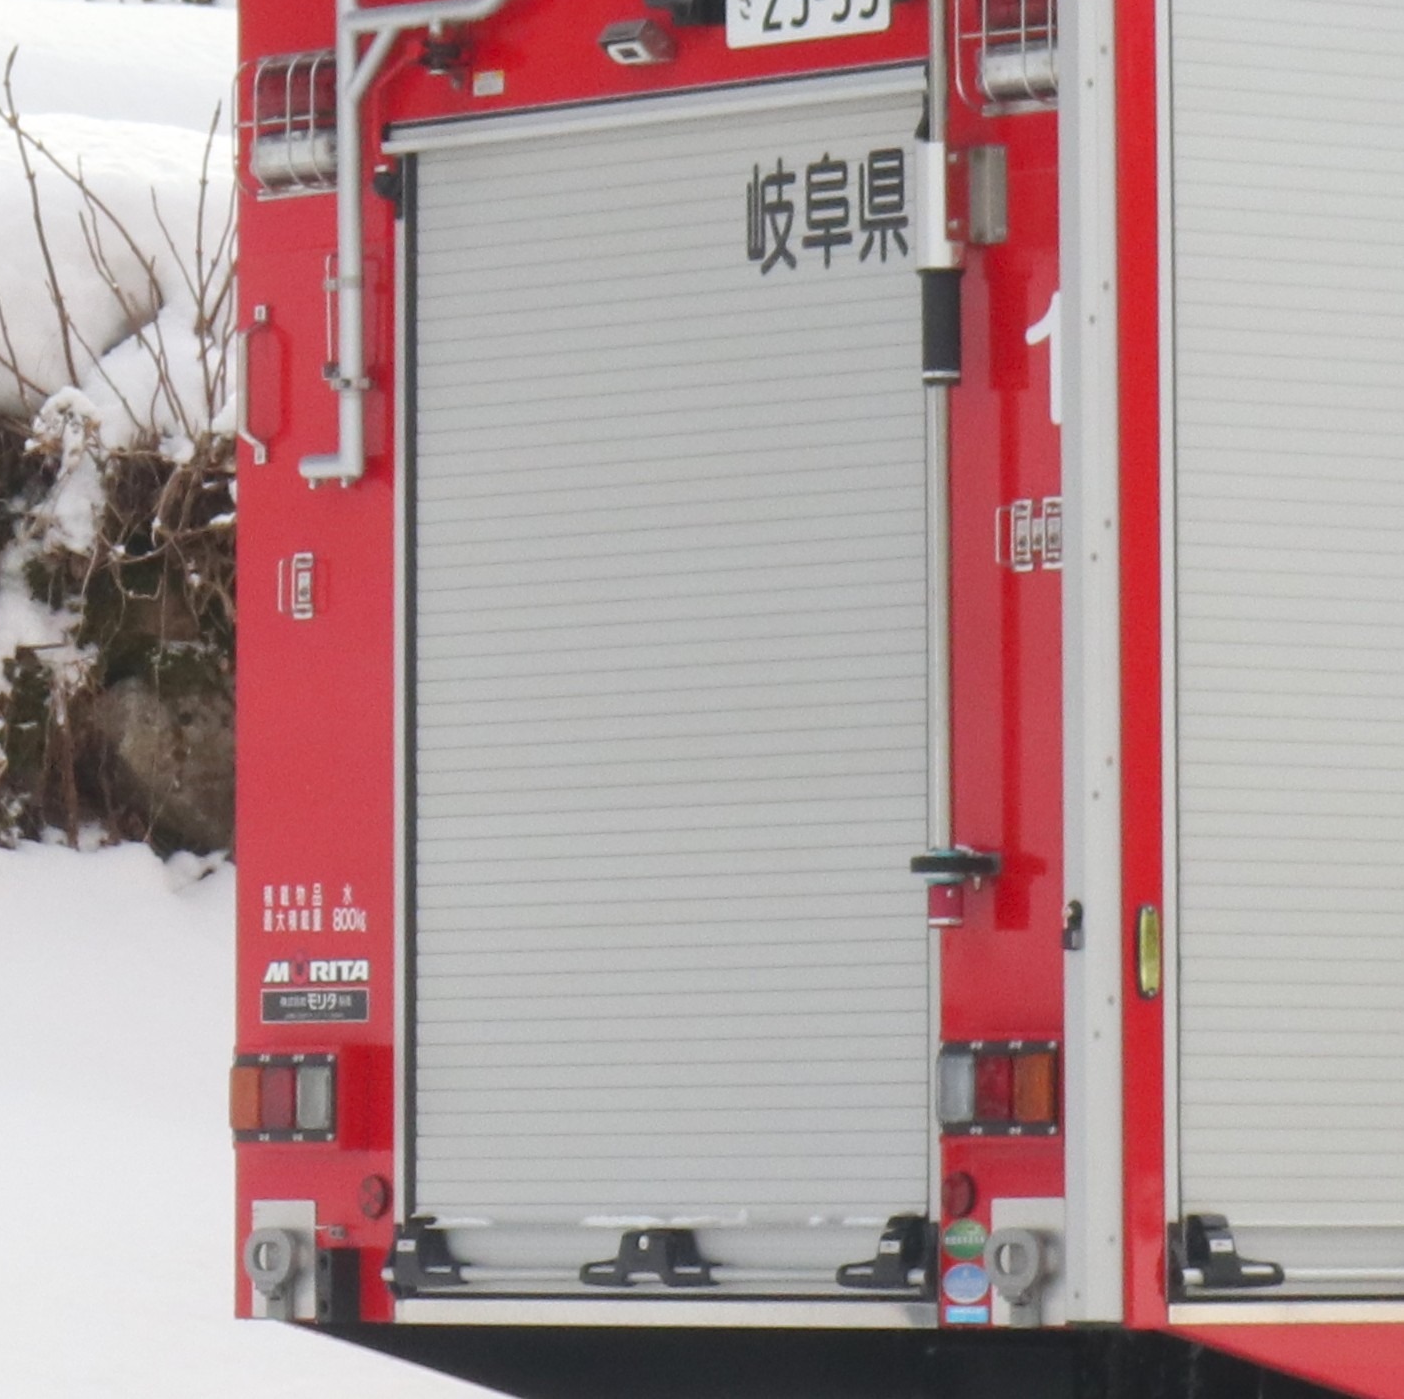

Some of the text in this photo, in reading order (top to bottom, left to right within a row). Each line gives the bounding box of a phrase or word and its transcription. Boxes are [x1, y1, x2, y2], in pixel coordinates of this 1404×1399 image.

[747, 148, 908, 275] 岐阜県
[263, 956, 369, 984] MORITA
